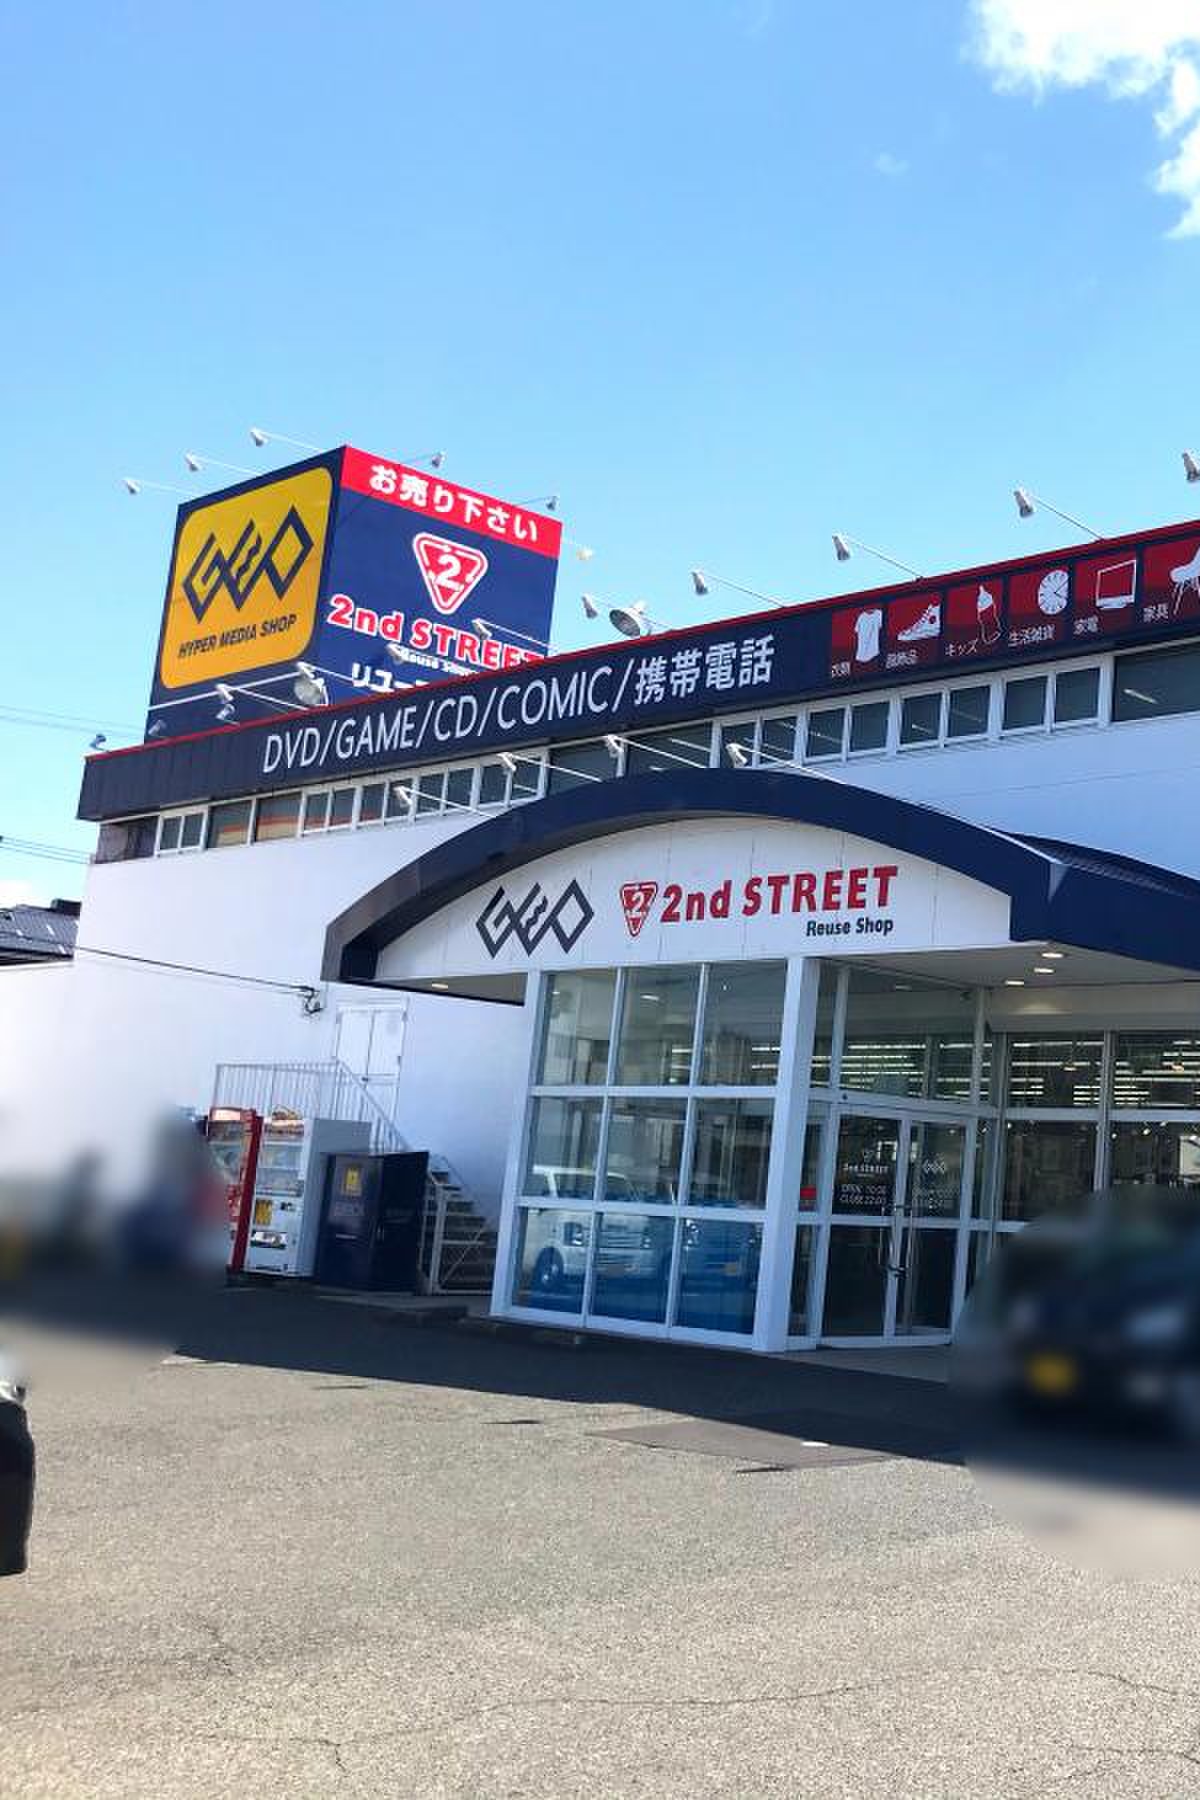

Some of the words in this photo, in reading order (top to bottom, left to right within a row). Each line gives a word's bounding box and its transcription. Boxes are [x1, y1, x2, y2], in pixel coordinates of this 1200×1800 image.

[370, 464, 539, 543] お売り下さい
[219, 624, 257, 649] MEDIA
[259, 613, 297, 637] SHOP
[327, 594, 404, 642] 2nd
[660, 880, 732, 923] 2nd
[742, 865, 898, 917] STREET
[805, 920, 850, 937] Reuse
[855, 916, 893, 936] Shop
